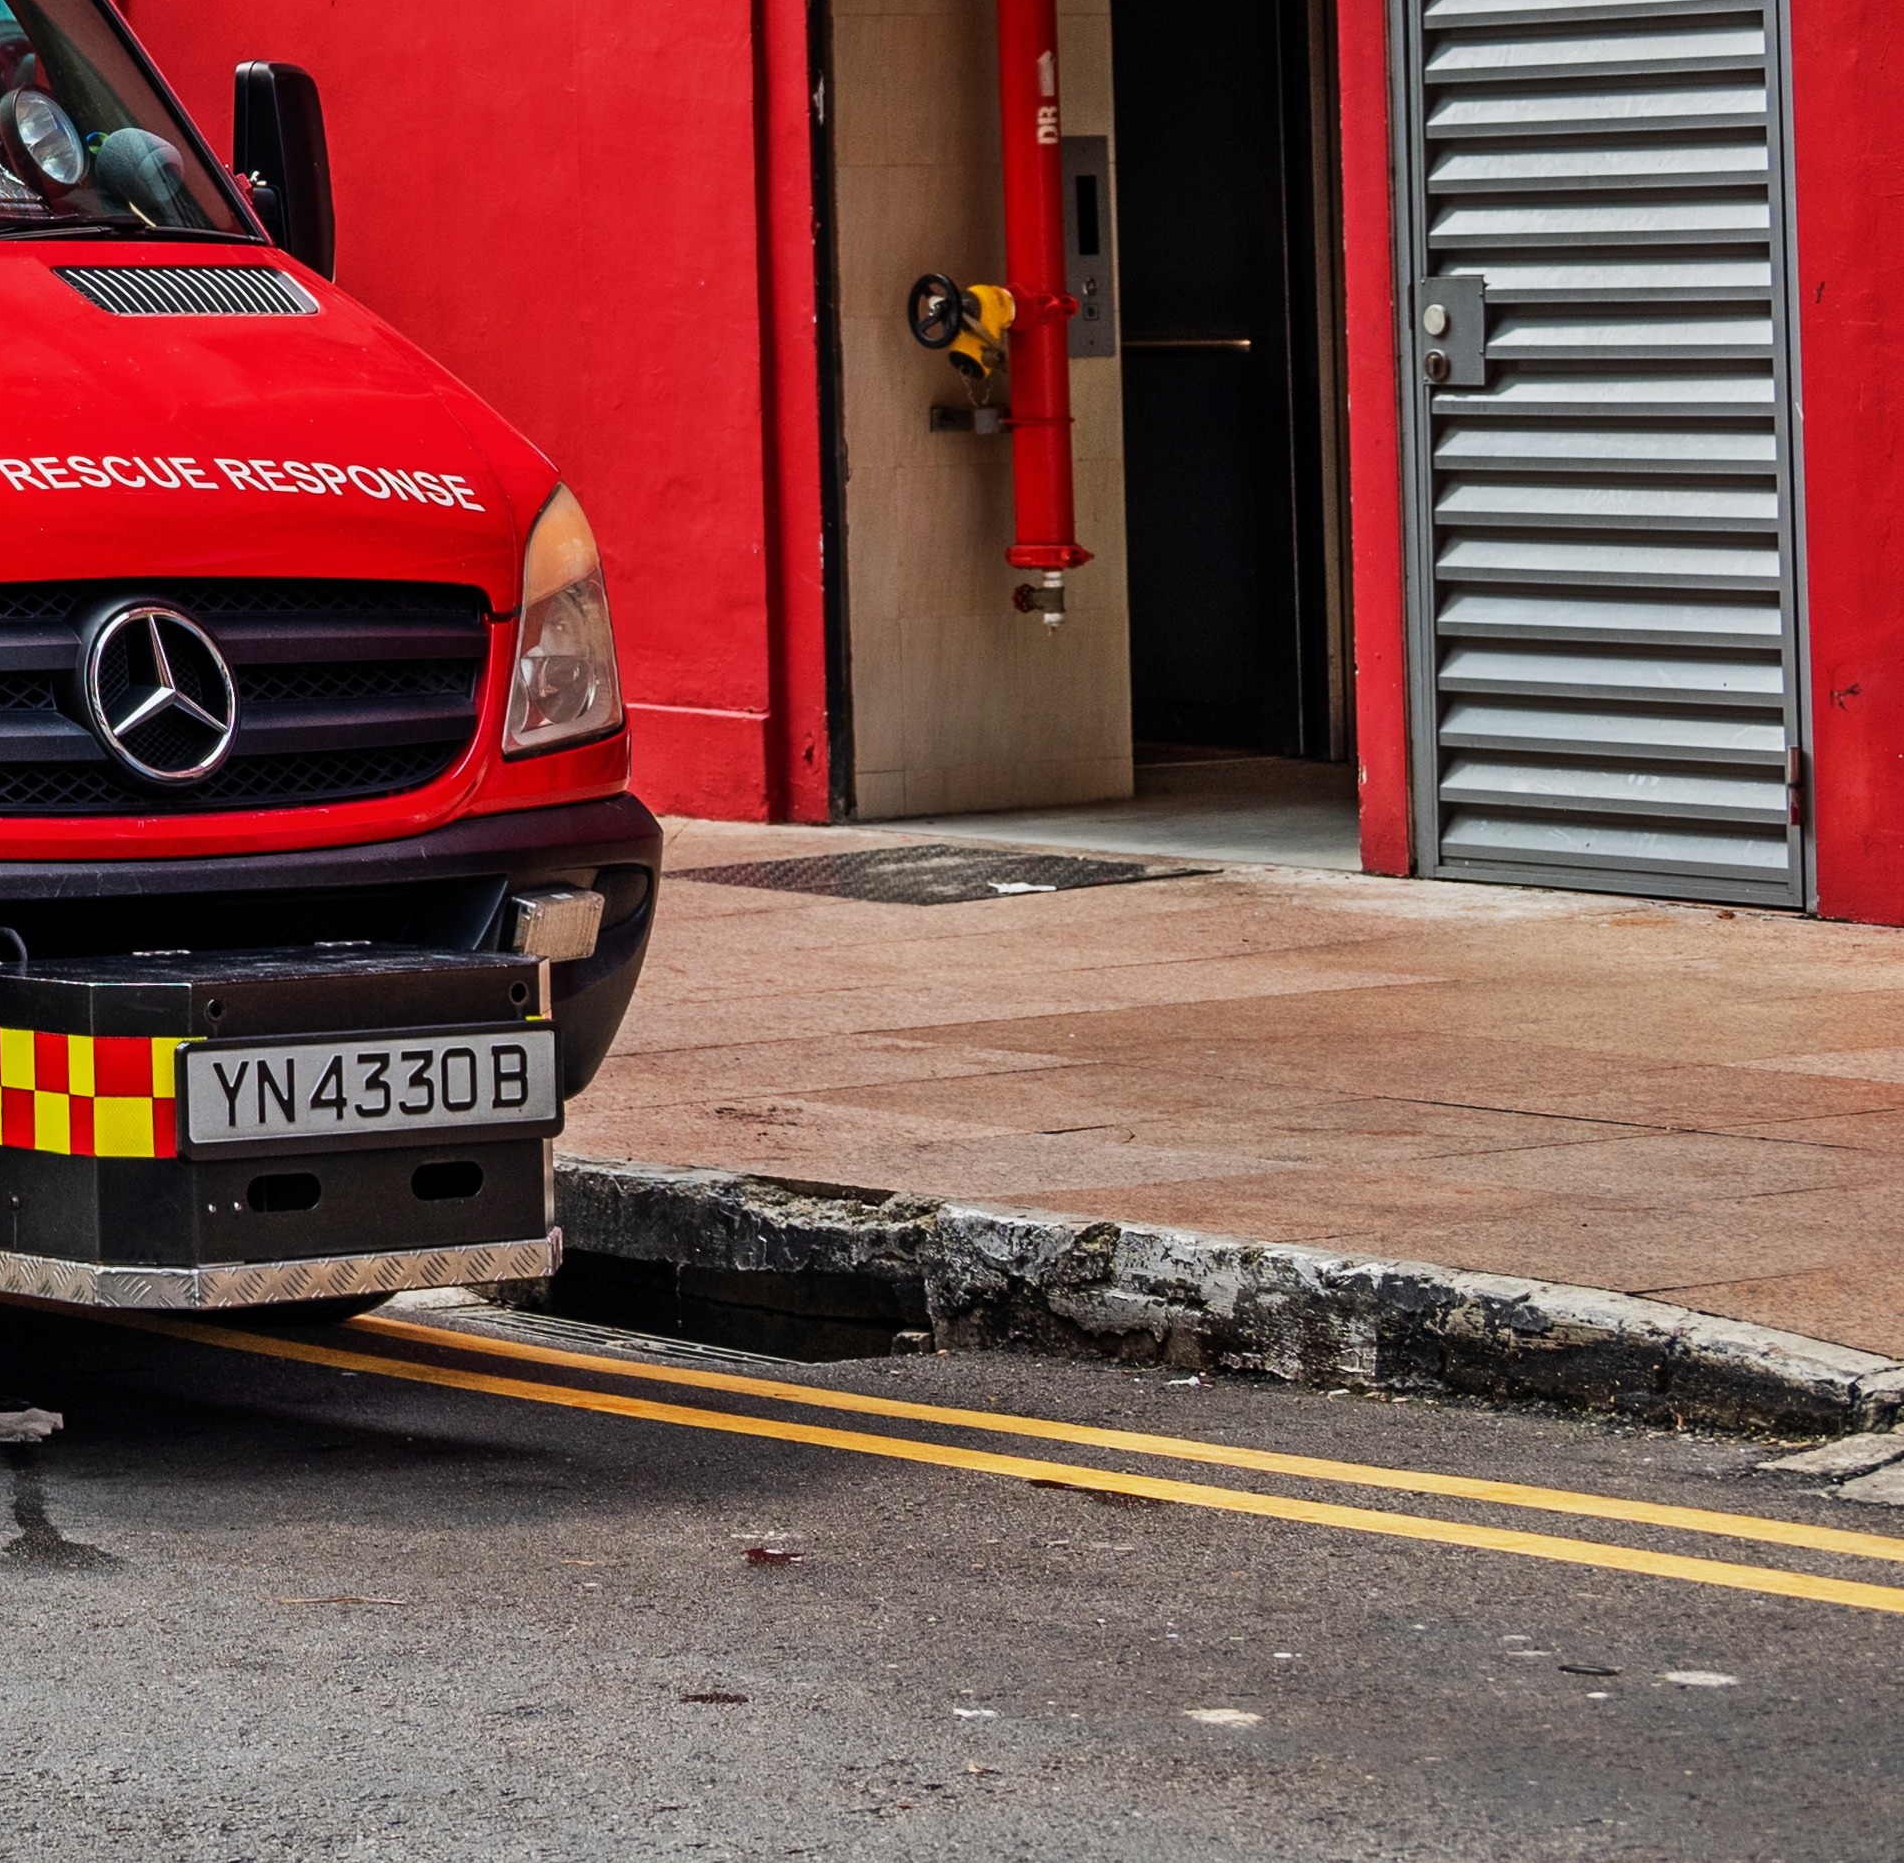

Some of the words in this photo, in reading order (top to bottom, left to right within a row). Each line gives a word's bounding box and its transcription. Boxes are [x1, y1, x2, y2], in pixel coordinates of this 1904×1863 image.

[1037, 105, 1059, 145] DR
[213, 458, 486, 512] RESPONSE
[212, 1044, 529, 1128] YN4330B
